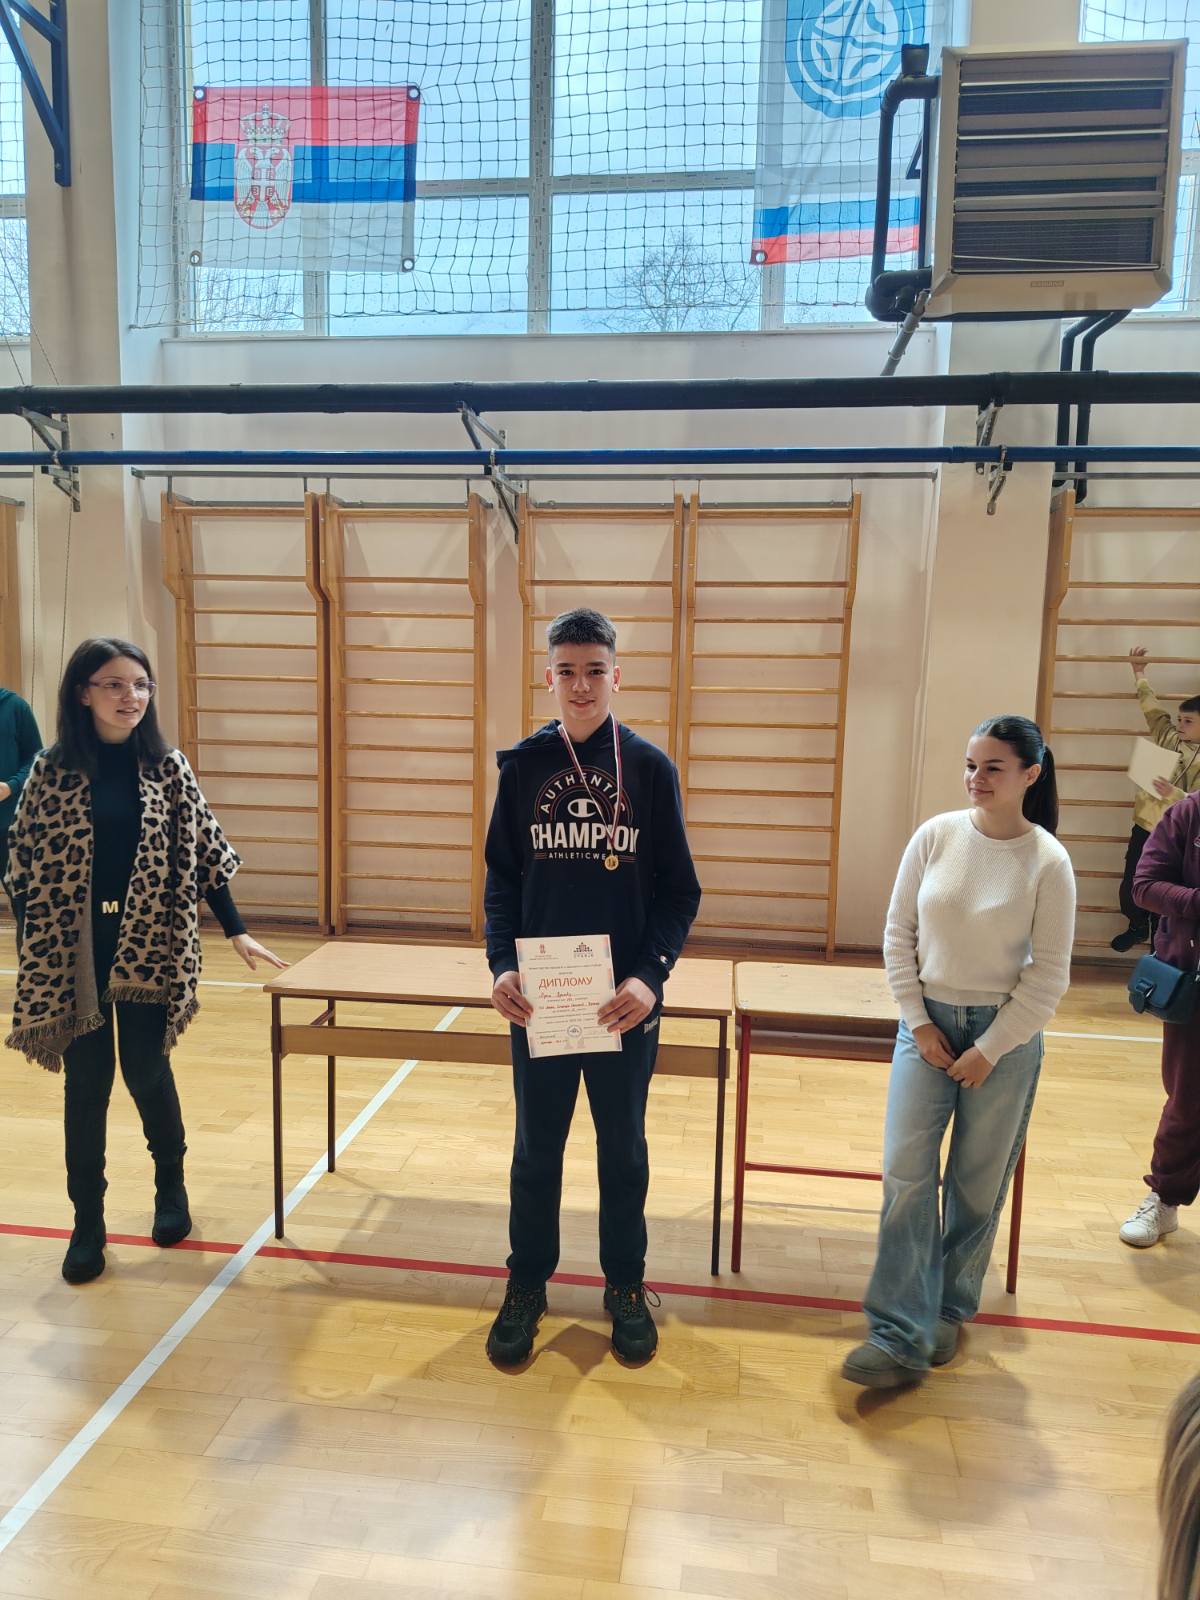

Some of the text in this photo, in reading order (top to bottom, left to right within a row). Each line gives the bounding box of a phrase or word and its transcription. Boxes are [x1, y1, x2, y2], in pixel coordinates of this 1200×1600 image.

[548, 852, 618, 861] ATHLETICWE
[102, 901, 119, 914] M
[538, 976, 593, 990] ДИПЛОМУ
